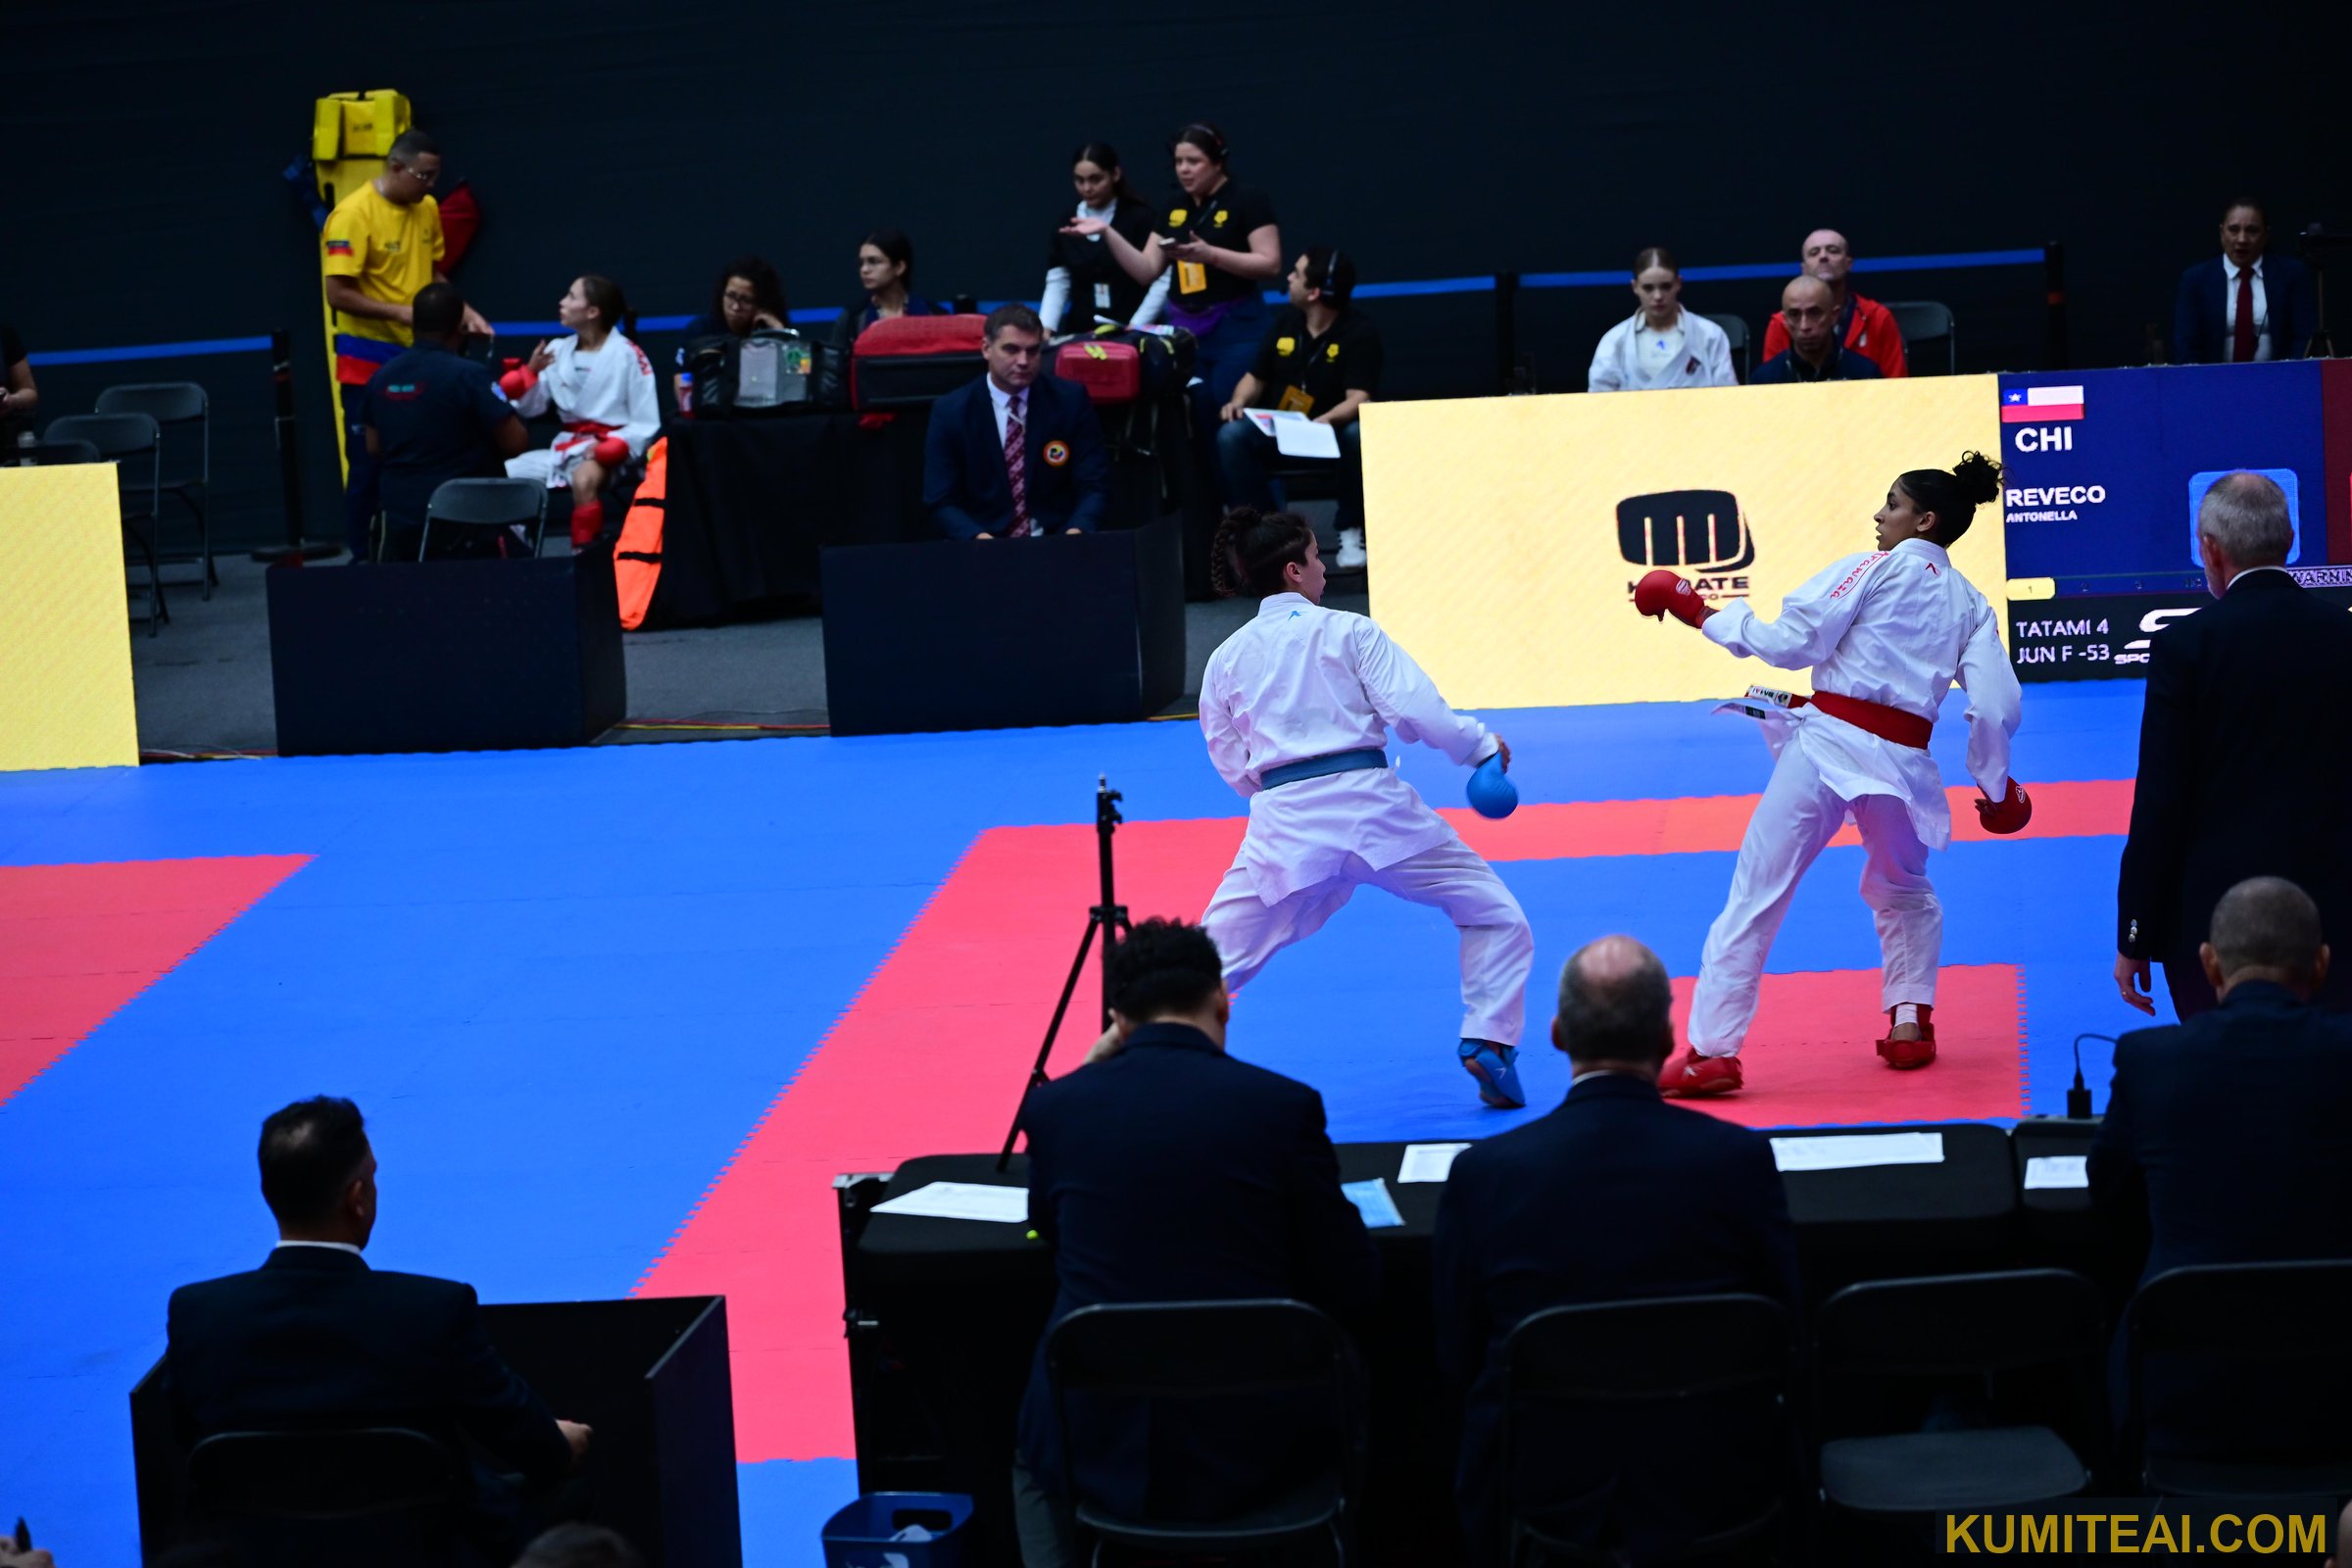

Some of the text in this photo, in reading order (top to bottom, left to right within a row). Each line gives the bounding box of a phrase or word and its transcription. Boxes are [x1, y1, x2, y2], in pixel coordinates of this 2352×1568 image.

[2015, 426, 2073, 452] CHI
[2006, 485, 2106, 507] REVECO
[2006, 510, 2078, 522] ANTONELLA
[2016, 618, 2109, 637] TATAMI 4
[2017, 645, 2110, 663] JUN F -53
